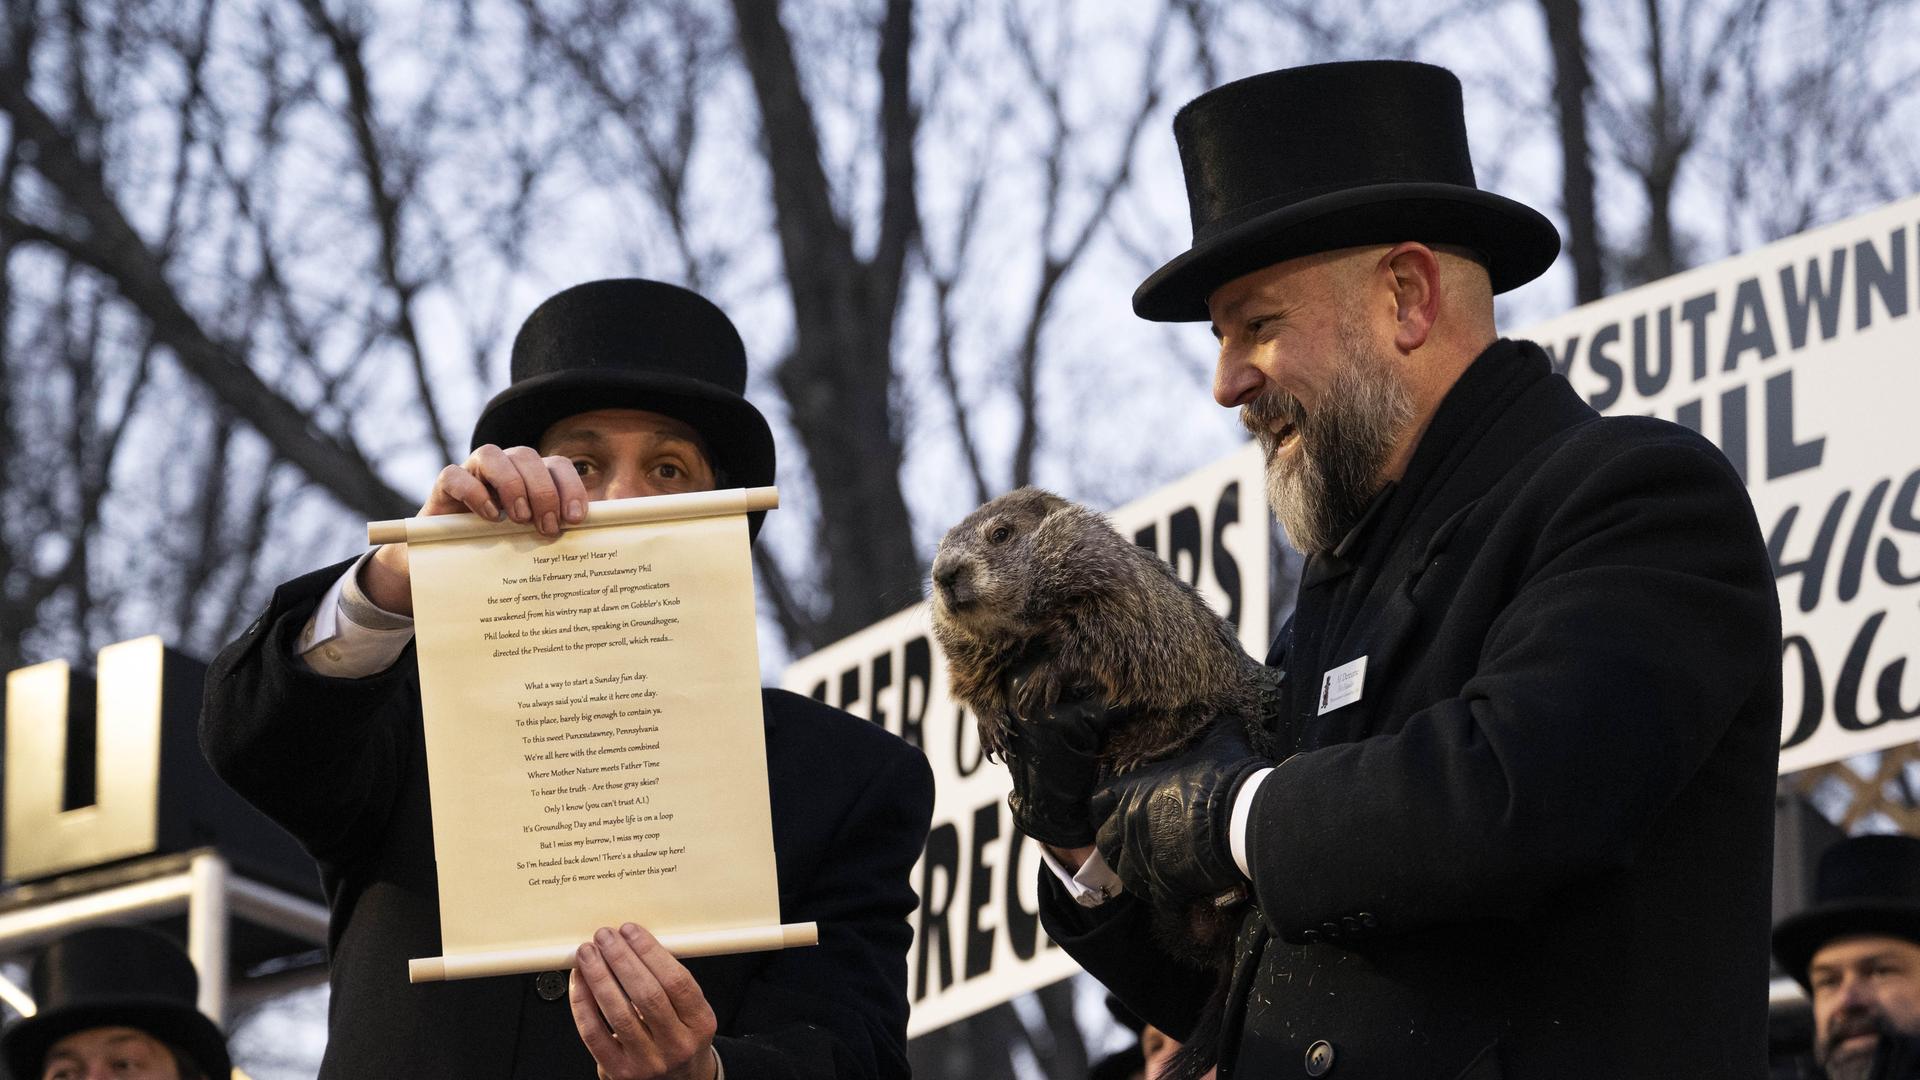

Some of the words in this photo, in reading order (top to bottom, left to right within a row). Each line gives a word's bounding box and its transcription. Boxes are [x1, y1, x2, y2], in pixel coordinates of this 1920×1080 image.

[533, 556, 549, 565] Hear
[551, 554, 561, 565] ye!
[562, 553, 578, 562] Hear
[580, 553, 589, 563] ye!
[591, 551, 606, 560] Hear
[608, 549, 618, 560] ye!
[529, 574, 541, 583] this
[542, 572, 572, 581] February
[590, 568, 637, 578] Punxsutawney
[638, 564, 652, 573] Phil
[514, 593, 521, 605] of
[541, 592, 552, 600] the
[553, 587, 601, 600] prognosticator
[602, 585, 609, 596] of
[609, 585, 618, 594] all
[619, 582, 670, 593] prognosticators
[493, 611, 526, 622] awakened
[526, 610, 543, 621] from
[544, 609, 555, 617] his
[556, 607, 578, 617] wintry
[579, 607, 592, 616] nap
[601, 603, 620, 611] dawn
[630, 599, 661, 609] Gobbler's
[662, 597, 680, 606] Knob
[499, 630, 520, 639] looked
[541, 627, 558, 635] skies
[559, 625, 572, 634] and
[592, 621, 621, 633] speaking
[622, 620, 629, 628] in
[630, 616, 679, 627] Groundhogese,
[493, 648, 520, 658] directed
[521, 647, 532, 655] the
[533, 645, 564, 654] President
[573, 642, 584, 650] the
[585, 640, 607, 653] proper
[608, 638, 628, 647] scroll,
[629, 635, 649, 645] which
[524, 682, 544, 690] What
[572, 678, 588, 686] start
[595, 675, 619, 684] Sunday
[620, 673, 633, 683] fun
[634, 672, 648, 681] day.
[518, 701, 531, 709] You
[532, 700, 554, 709] always
[570, 695, 588, 706] you'd
[589, 694, 607, 702] make
[615, 692, 630, 700] here
[644, 689, 658, 699] day.
[526, 718, 539, 726] this
[540, 716, 559, 727] place,
[560, 714, 580, 723] barely
[581, 713, 592, 722] big
[593, 710, 618, 720] enough
[627, 708, 652, 717] contain
[652, 708, 662, 717] ya.
[533, 735, 545, 743] this
[546, 734, 564, 742] sweet
[616, 725, 659, 736] Pennsylvania
[524, 754, 544, 762] We're
[545, 752, 554, 760] all
[555, 751, 569, 759] here
[570, 749, 584, 757] with
[598, 745, 627, 755] elements
[628, 741, 660, 752] combined
[527, 771, 550, 779] Where
[551, 768, 575, 777] Mother
[576, 767, 599, 775] Nature
[601, 764, 619, 772] meets
[621, 762, 642, 770] Father
[643, 760, 660, 768] Time
[541, 788, 556, 796] hear
[557, 786, 568, 794] the
[569, 784, 587, 793] truth
[592, 783, 604, 791] Are
[606, 782, 623, 790] those
[624, 781, 639, 790] gray
[640, 778, 659, 786] skies?
[544, 805, 561, 814] Only
[585, 802, 600, 811] (you
[601, 799, 617, 808] can't
[618, 797, 635, 806] trust
[523, 825, 533, 833] It's
[534, 820, 573, 832] Groundhog
[574, 820, 587, 829] Day
[588, 818, 602, 827] and
[603, 816, 624, 827] maybe
[625, 814, 636, 826] life
[659, 812, 673, 822] loop
[540, 841, 552, 849] But
[558, 839, 572, 847] miss
[574, 839, 584, 847] my
[585, 837, 611, 845] burrow,
[617, 833, 632, 841] miss
[633, 833, 643, 841] my
[644, 832, 660, 842] coop
[517, 862, 525, 870] So
[526, 860, 538, 868] I'm
[539, 858, 562, 867] headed
[563, 856, 579, 864] back
[580, 853, 601, 863] down!
[602, 851, 626, 861] There's
[632, 848, 658, 859] shadow
[659, 849, 668, 858] up
[669, 846, 686, 854] here!
[528, 877, 540, 886] Get
[541, 876, 561, 885] ready
[560, 874, 571, 885] for
[578, 873, 596, 881] more
[597, 871, 616, 879] weeks
[617, 869, 625, 879] of
[625, 868, 646, 876] winter
[647, 865, 660, 874] this
[661, 865, 678, 875] year!
